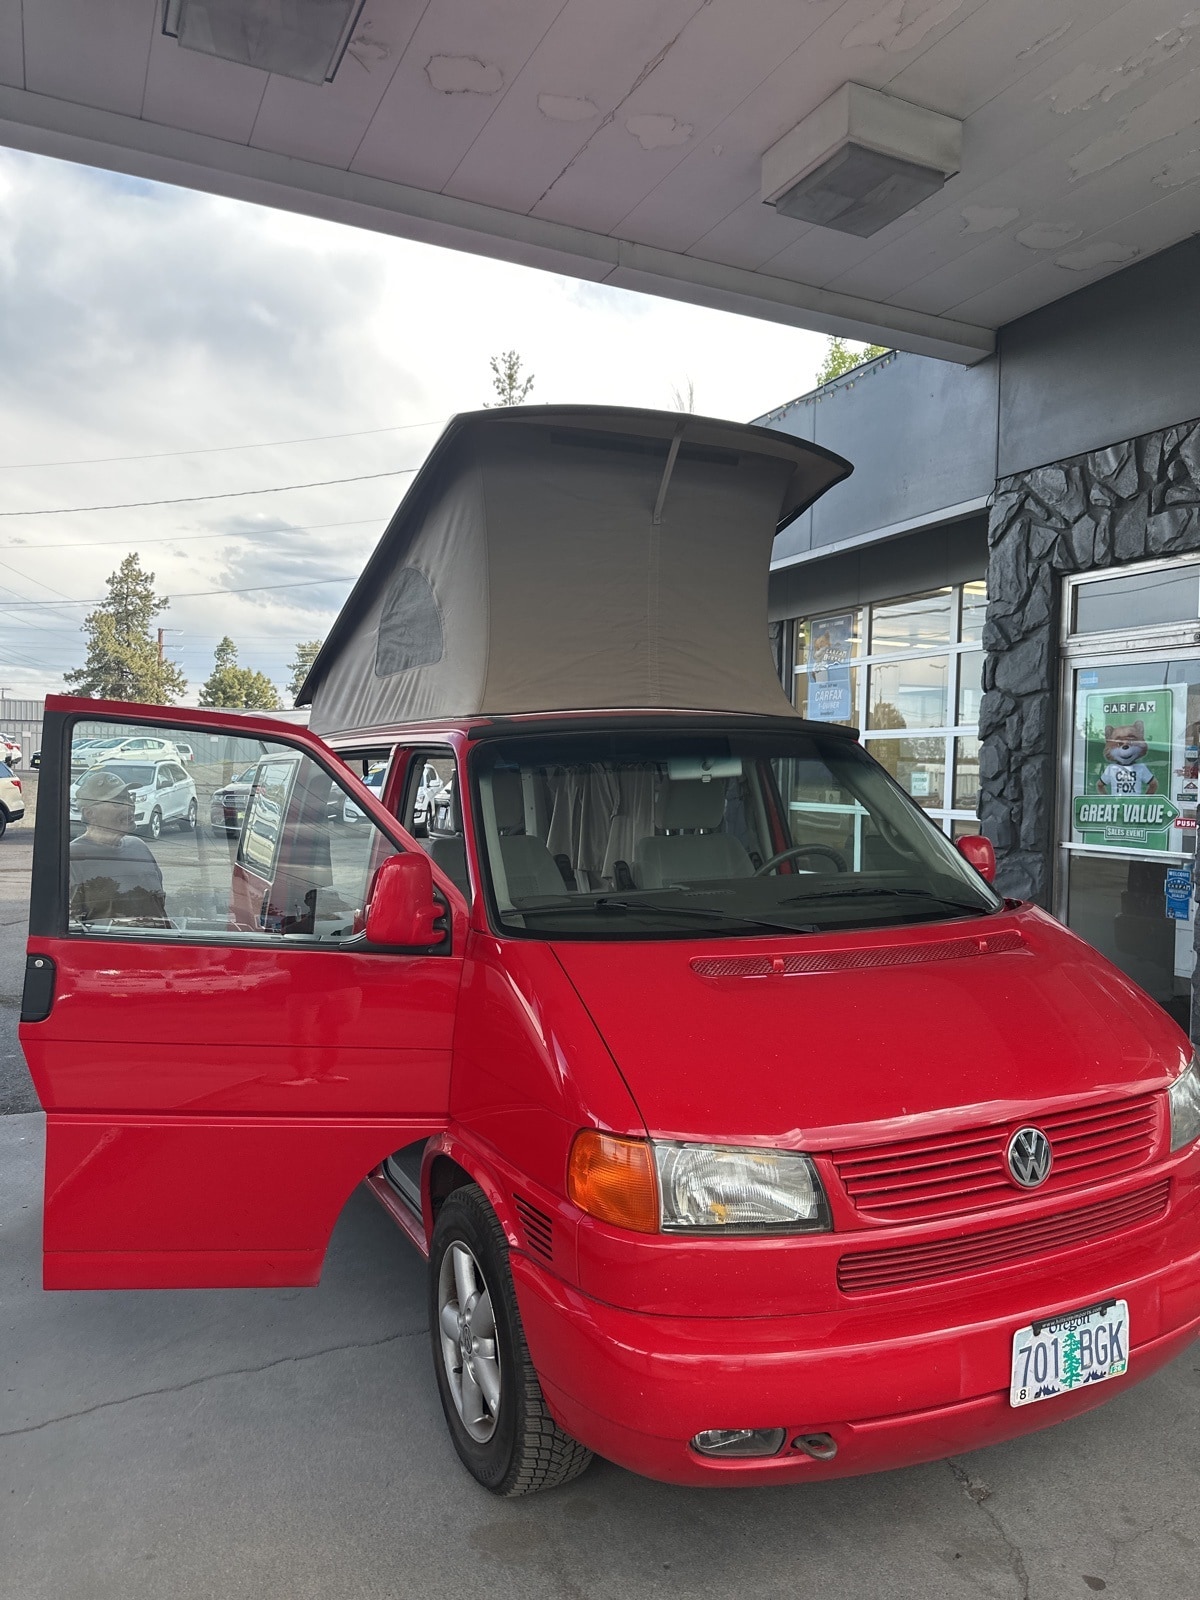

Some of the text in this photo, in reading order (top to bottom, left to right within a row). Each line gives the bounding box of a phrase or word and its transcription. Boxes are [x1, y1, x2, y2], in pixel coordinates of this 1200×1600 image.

[815, 689, 843, 702] CARFAX
[1103, 701, 1155, 713] CARFAX
[1115, 770, 1137, 782] CAR
[1116, 783, 1136, 793] FOX
[1080, 804, 1165, 823] GREAT VALUE
[1176, 820, 1196, 828] PUSH
[1107, 828, 1144, 838] SALES EVENT
[1048, 1315, 1091, 1335] Oregon
[1019, 1320, 1125, 1388] 701 BGK
[1019, 1389, 1027, 1400] 8
